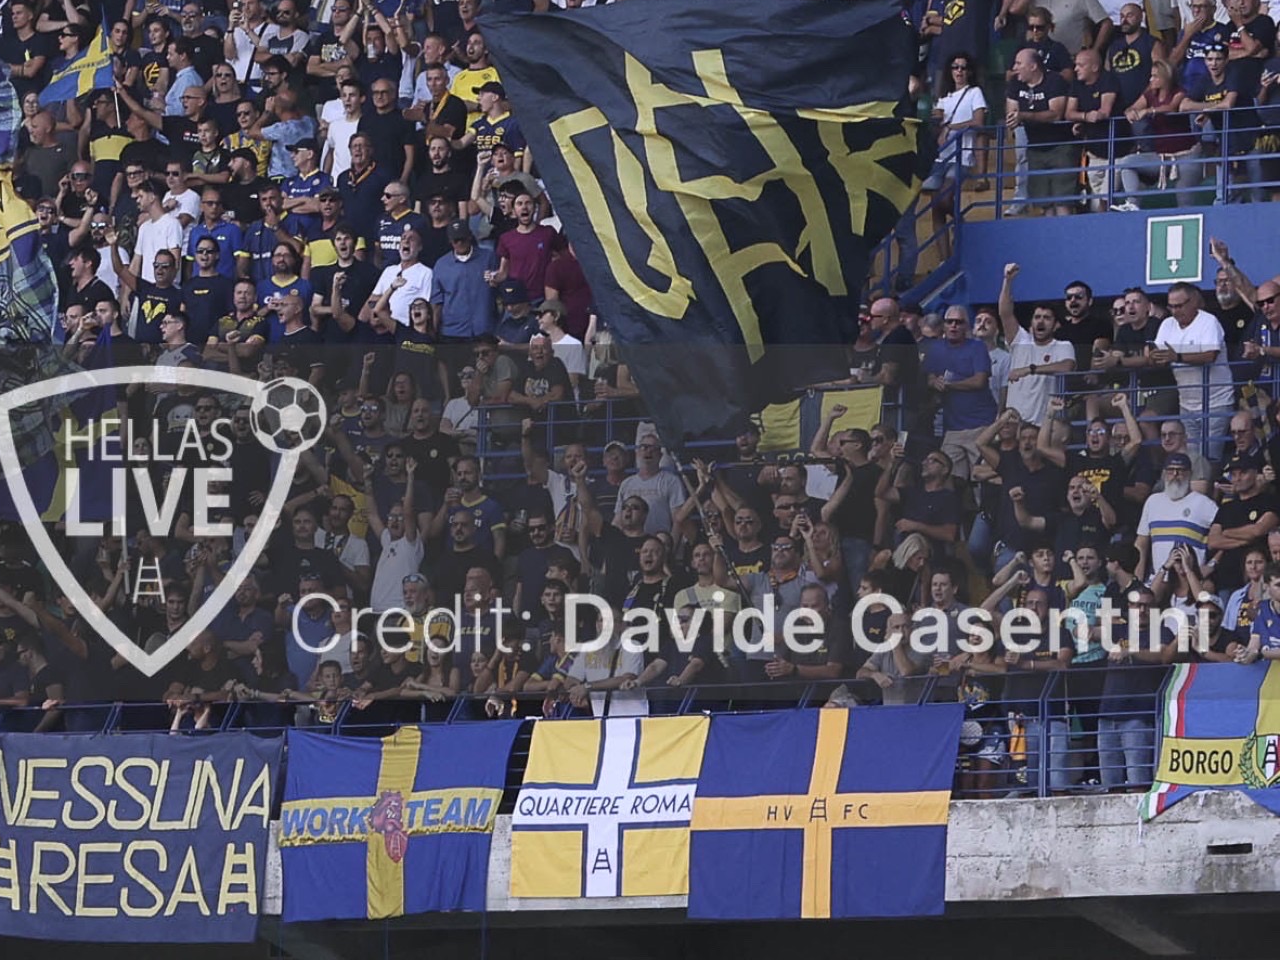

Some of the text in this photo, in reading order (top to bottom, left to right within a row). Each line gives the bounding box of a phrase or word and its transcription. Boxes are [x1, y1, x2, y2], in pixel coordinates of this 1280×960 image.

[1168, 748, 1234, 775] BORGO
[282, 796, 493, 837] WORK TEAM
[518, 793, 693, 817] QUARTIERE ROMA
